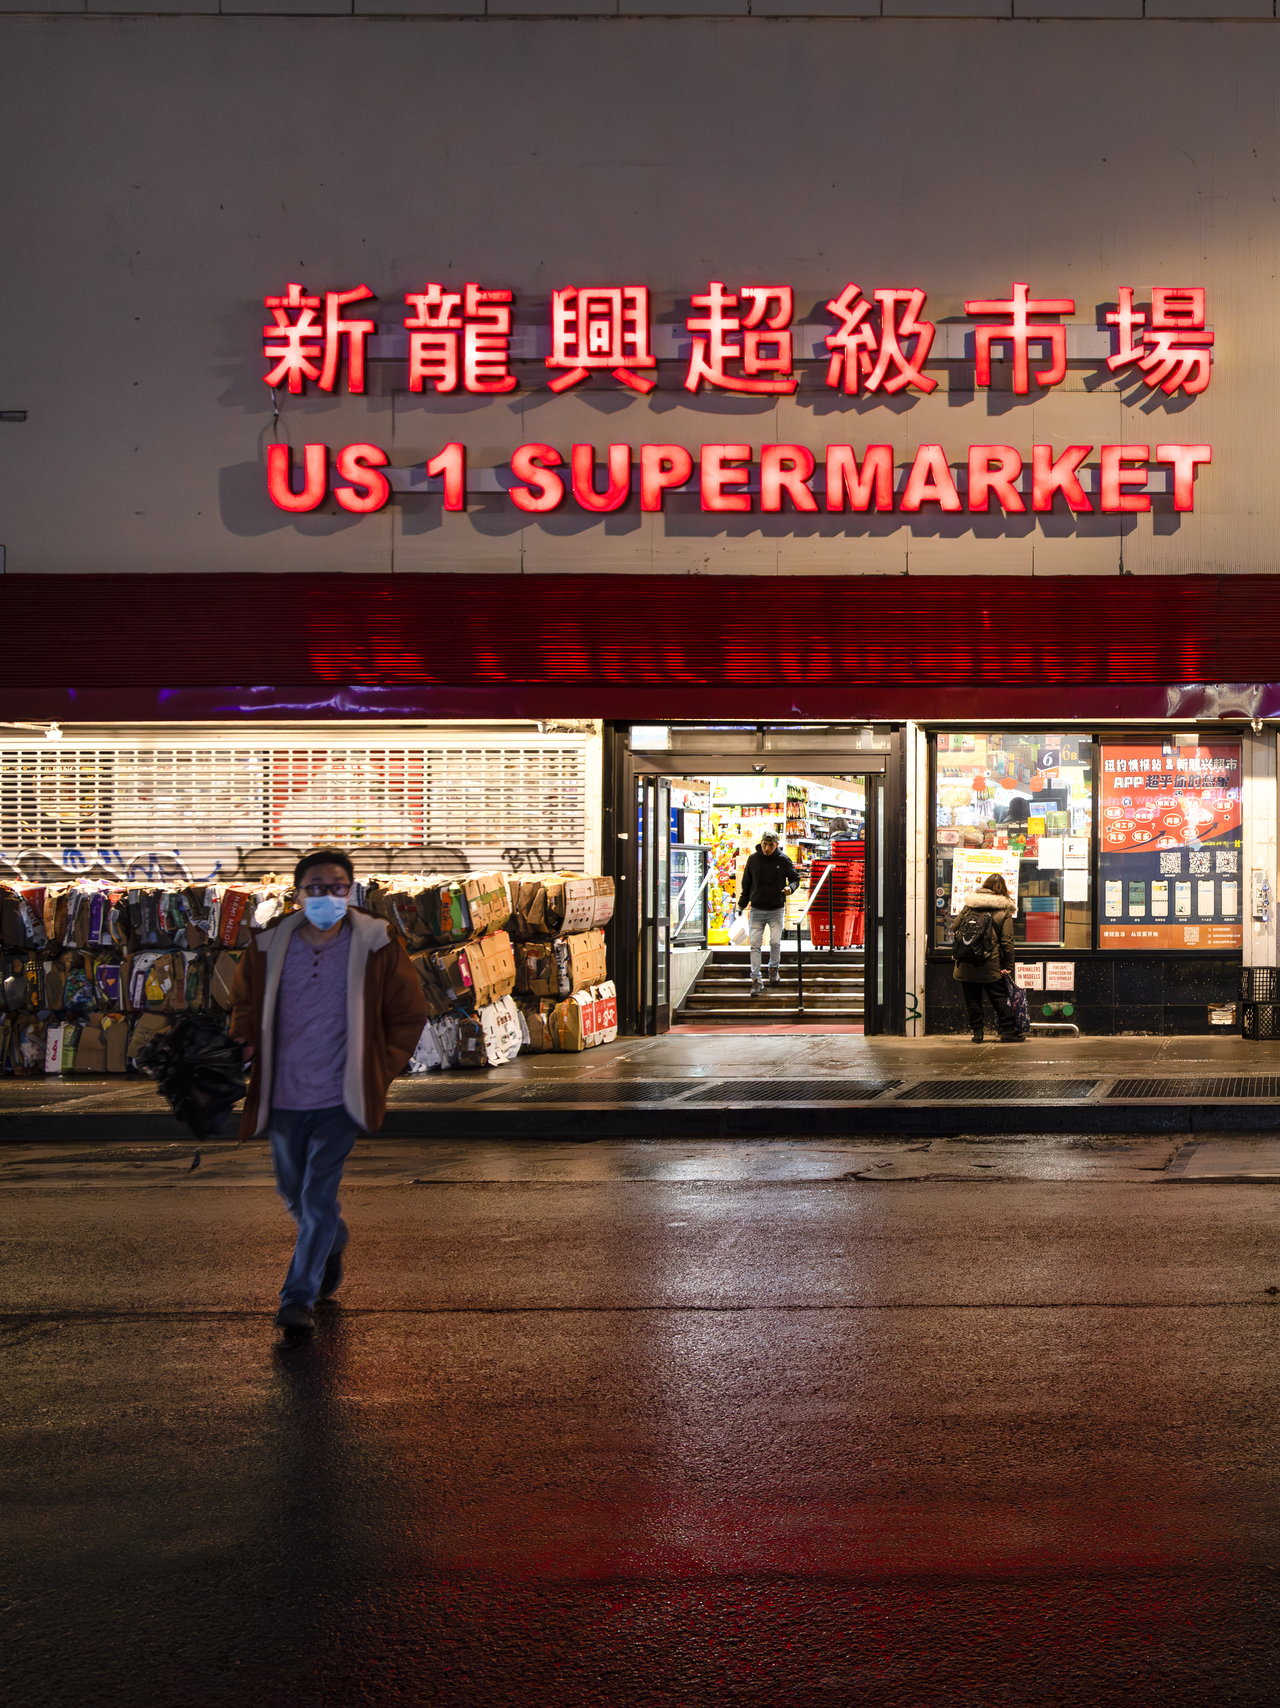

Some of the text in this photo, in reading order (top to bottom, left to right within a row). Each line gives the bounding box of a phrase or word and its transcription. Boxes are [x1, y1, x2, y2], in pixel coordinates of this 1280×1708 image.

[263, 281, 1215, 397] 新龍興超級市場
[267, 443, 1213, 514] US 1 SUPERMARKET
[1113, 776, 1144, 789] APP
[229, 895, 241, 917] HAMI
